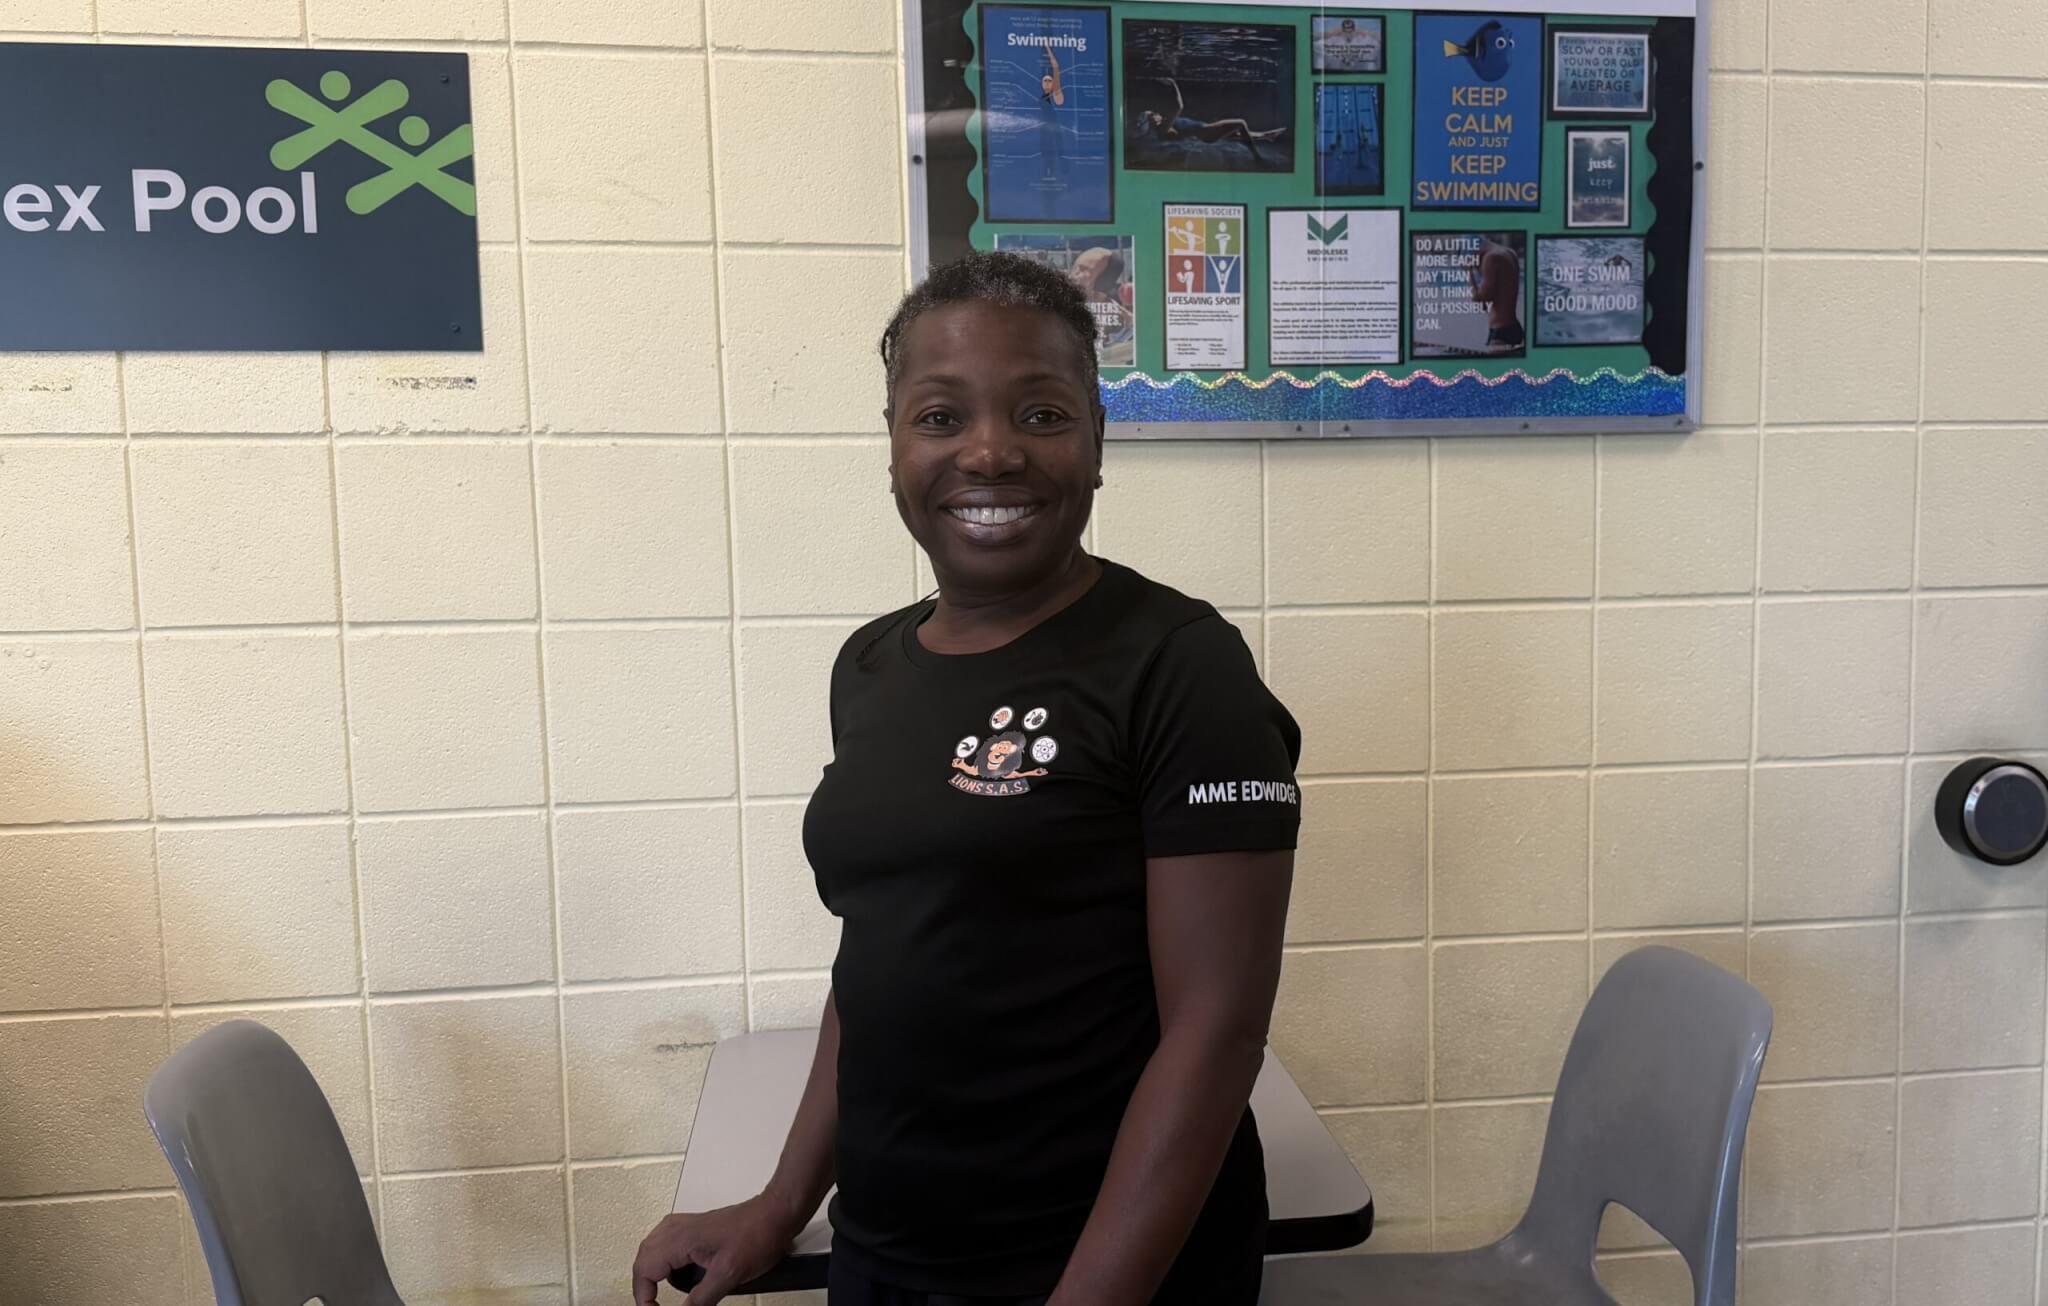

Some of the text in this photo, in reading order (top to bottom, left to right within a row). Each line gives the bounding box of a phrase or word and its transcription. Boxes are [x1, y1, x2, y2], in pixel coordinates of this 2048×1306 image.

[1007, 32, 1087, 52] Swimming
[1561, 46, 1641, 56] SLOW OR FAST
[1563, 58, 1640, 67] YOUNG OR OLD
[1564, 68, 1635, 78] TALENTED OR
[1570, 80, 1632, 92] AVERAGE
[1452, 86, 1508, 107] KEEP
[1445, 114, 1512, 134] CALM
[1448, 136, 1509, 148] AND JUST
[1451, 155, 1506, 175] KEEP
[1587, 157, 1616, 172] just
[1416, 181, 1538, 202] SWIMMING
[131, 168, 318, 234] Pool
[1168, 207, 1241, 216] LIFESAVING SOCIETY
[1416, 239, 1480, 251] DO A LITTLE
[1416, 254, 1480, 267] MORE EACH
[1416, 270, 1471, 283] DAY THAN
[1553, 266, 1630, 282] ONE SWIM
[1416, 286, 1473, 299] YOU THINK
[1168, 296, 1241, 306] LIFESAVING SPORT
[1544, 295, 1637, 312] GOOD MOOD
[1416, 302, 1493, 314] YOU POSSIBLY
[1416, 318, 1441, 330] CAN.
[951, 774, 1029, 795] LIONS S.A.S.
[1188, 780, 1297, 805] MME EDWIDGE
